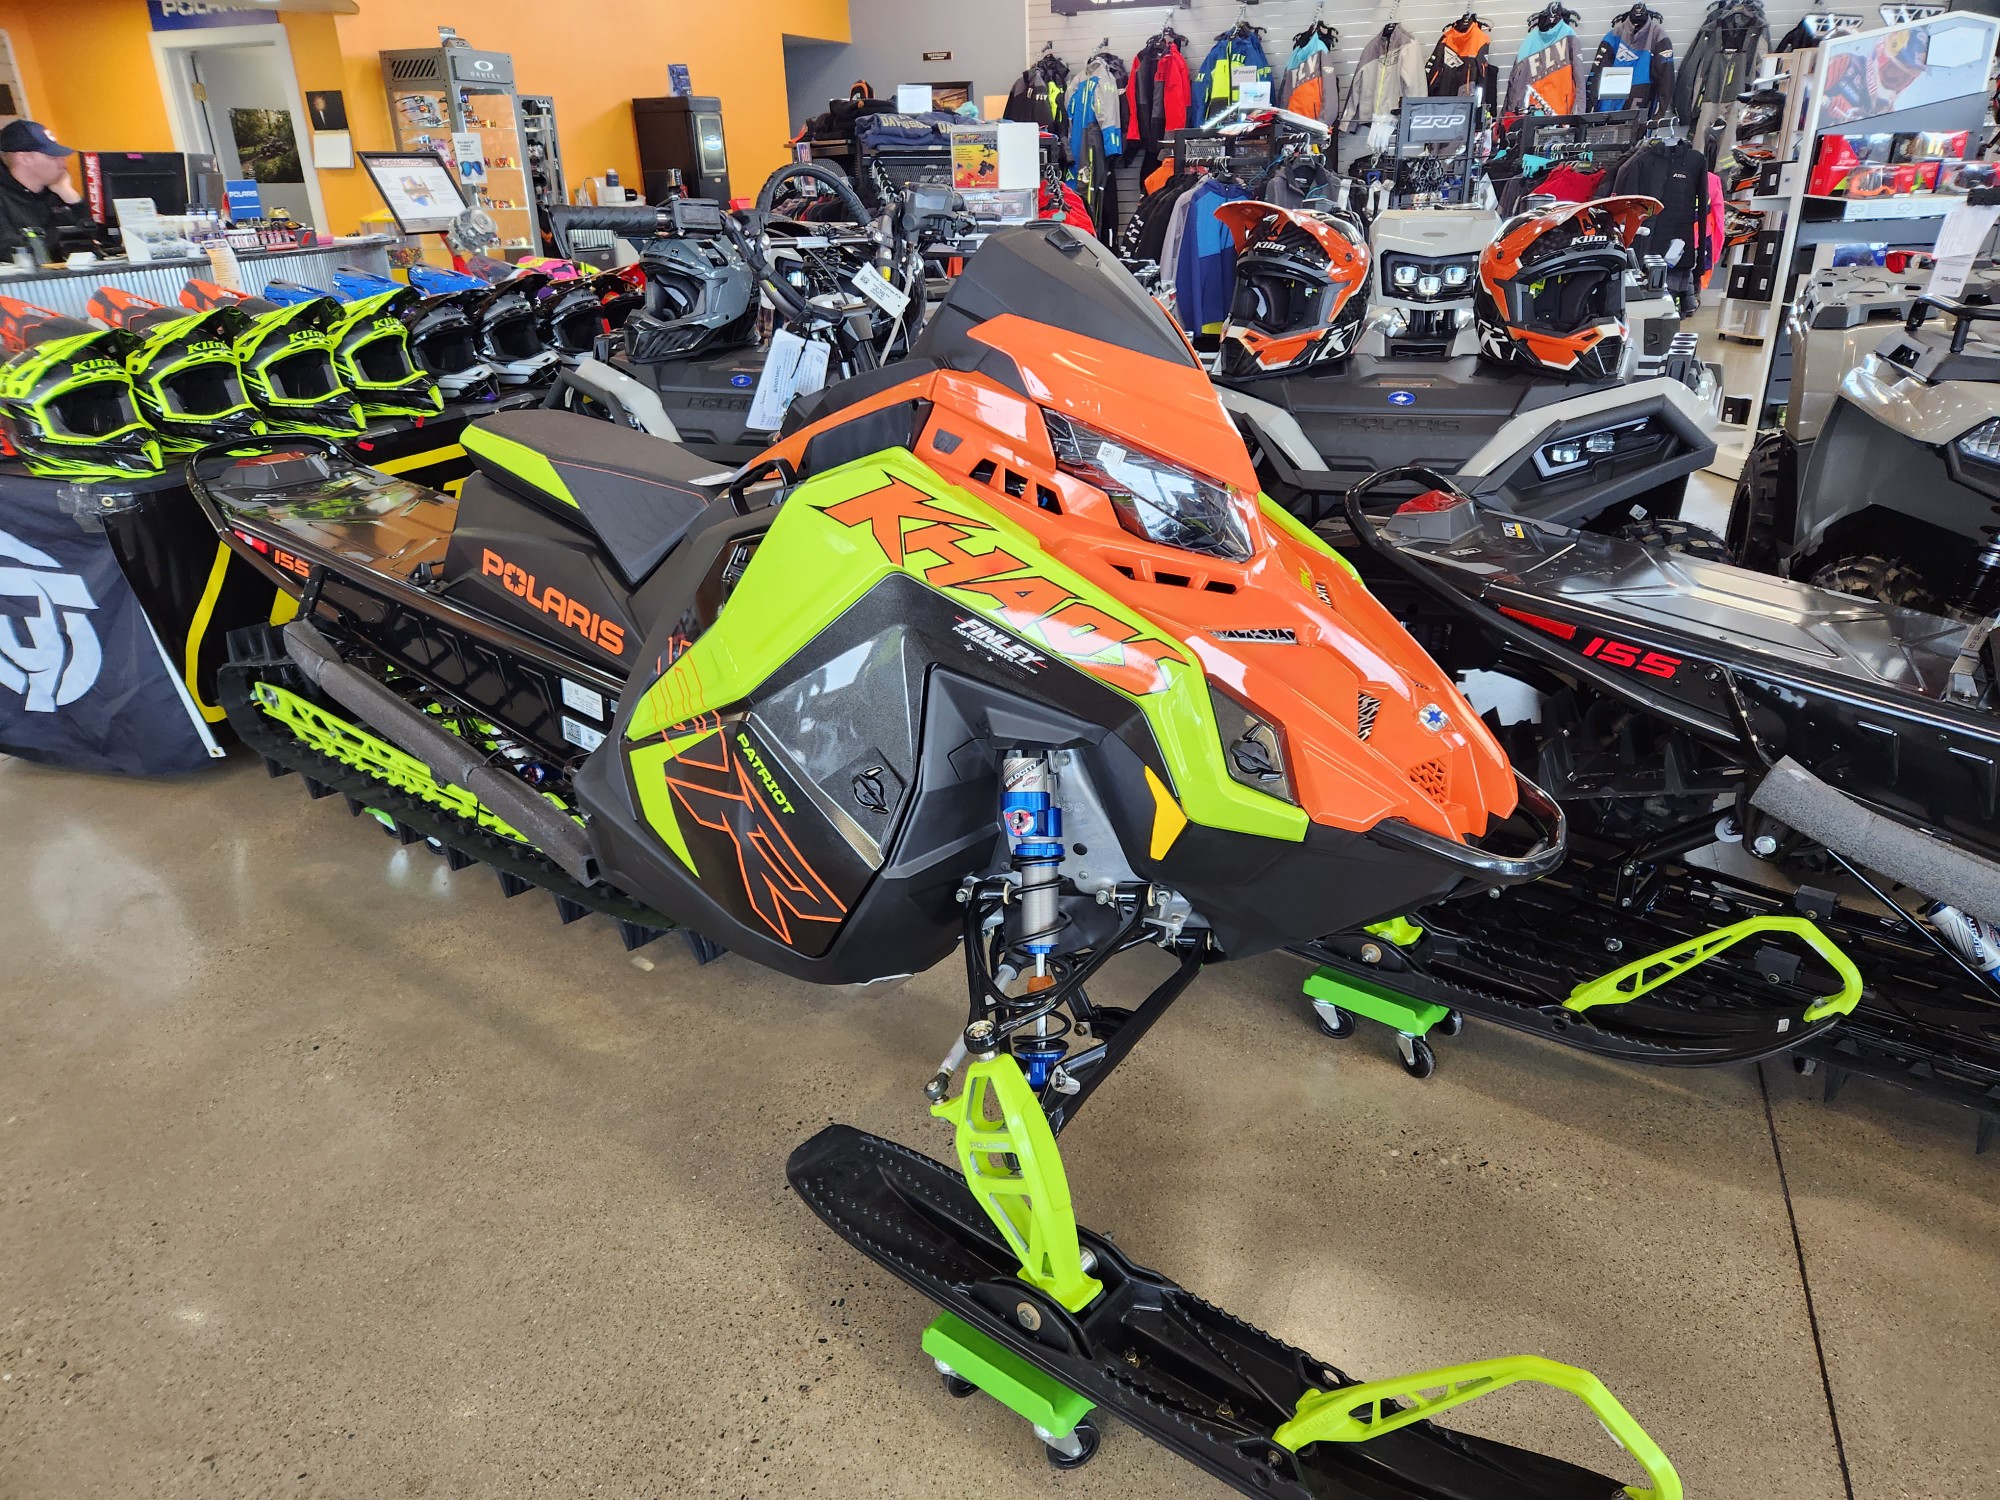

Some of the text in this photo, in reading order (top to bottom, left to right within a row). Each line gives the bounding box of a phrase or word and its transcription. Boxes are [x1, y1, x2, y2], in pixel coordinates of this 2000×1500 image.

[1231, 53, 1246, 62] FLY
[1527, 37, 1569, 77] FLY
[1410, 115, 1466, 129] ZRP
[84, 154, 104, 224] RACELINE
[228, 190, 258, 198] POLARIS
[1253, 241, 1287, 251] Klim
[1571, 234, 1608, 246] Klim
[1337, 417, 1461, 433] POLARIS
[274, 549, 311, 579] 155
[806, 469, 1193, 697] KHAOS
[481, 547, 626, 656] POLARIS
[952, 625, 1016, 664] MOTORSPORTS
[956, 618, 1047, 665] FINLEY
[1582, 637, 1683, 679] 155
[736, 732, 796, 815] PATRIOT
[1966, 916, 1985, 959] VELOCITY
